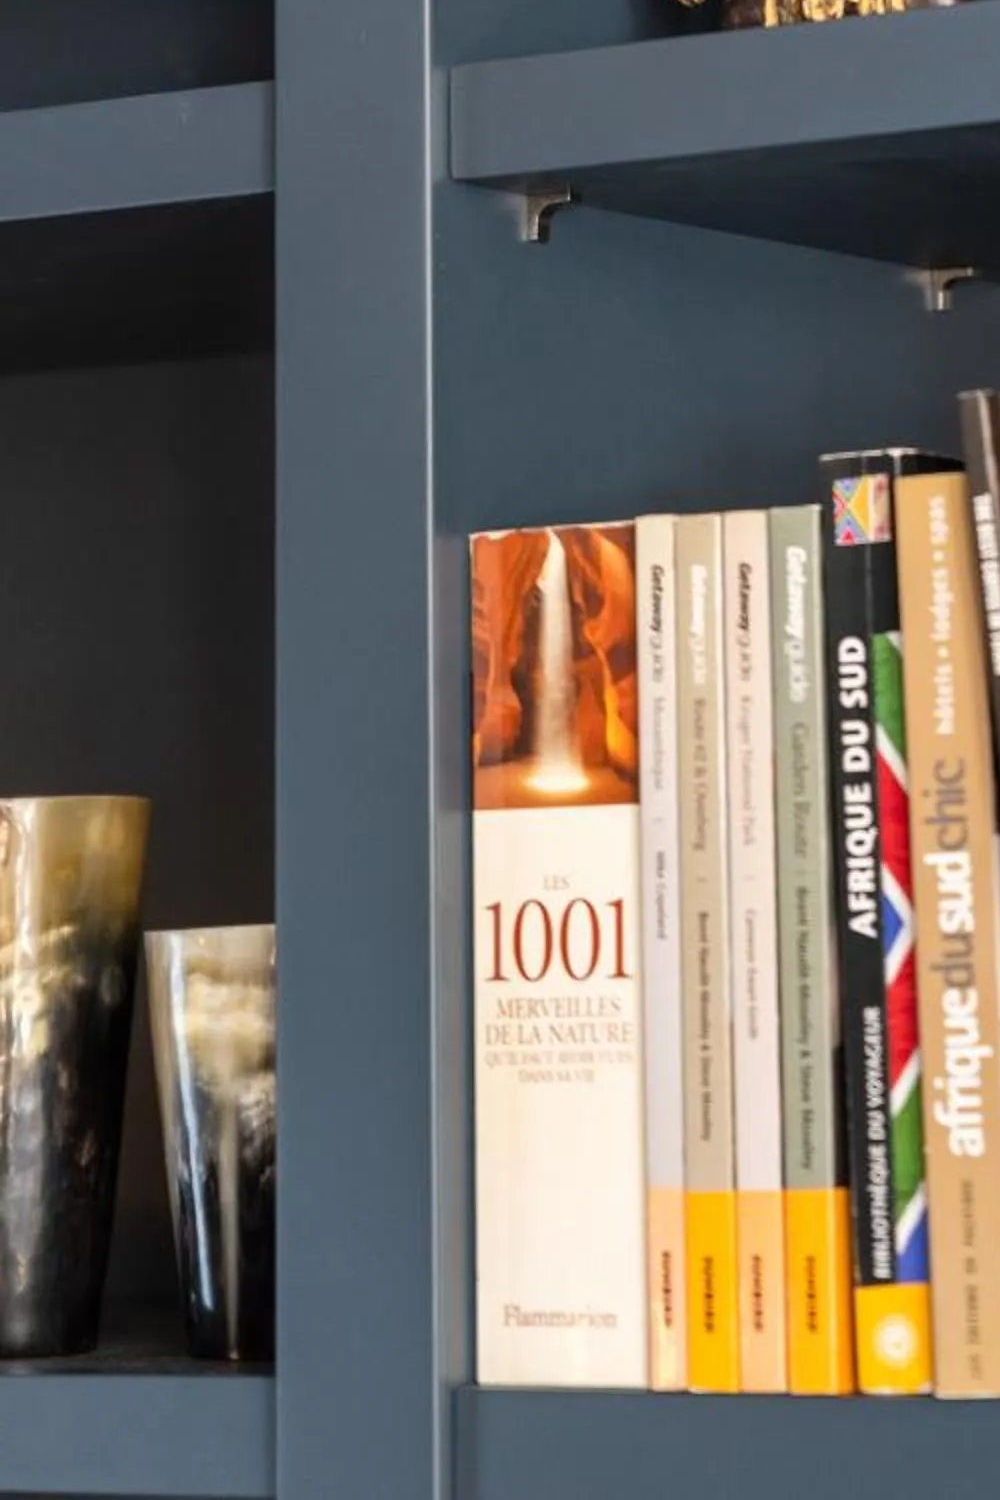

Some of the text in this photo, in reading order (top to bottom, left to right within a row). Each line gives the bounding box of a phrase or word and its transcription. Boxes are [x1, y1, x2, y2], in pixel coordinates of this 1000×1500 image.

[838, 636, 879, 938] AFRIQUE DU SUD
[485, 898, 632, 982] 1001
[496, 997, 622, 1018] MERVEILLES
[485, 1021, 634, 1046] DE LA NATURE
[867, 1111, 886, 1139] DU
